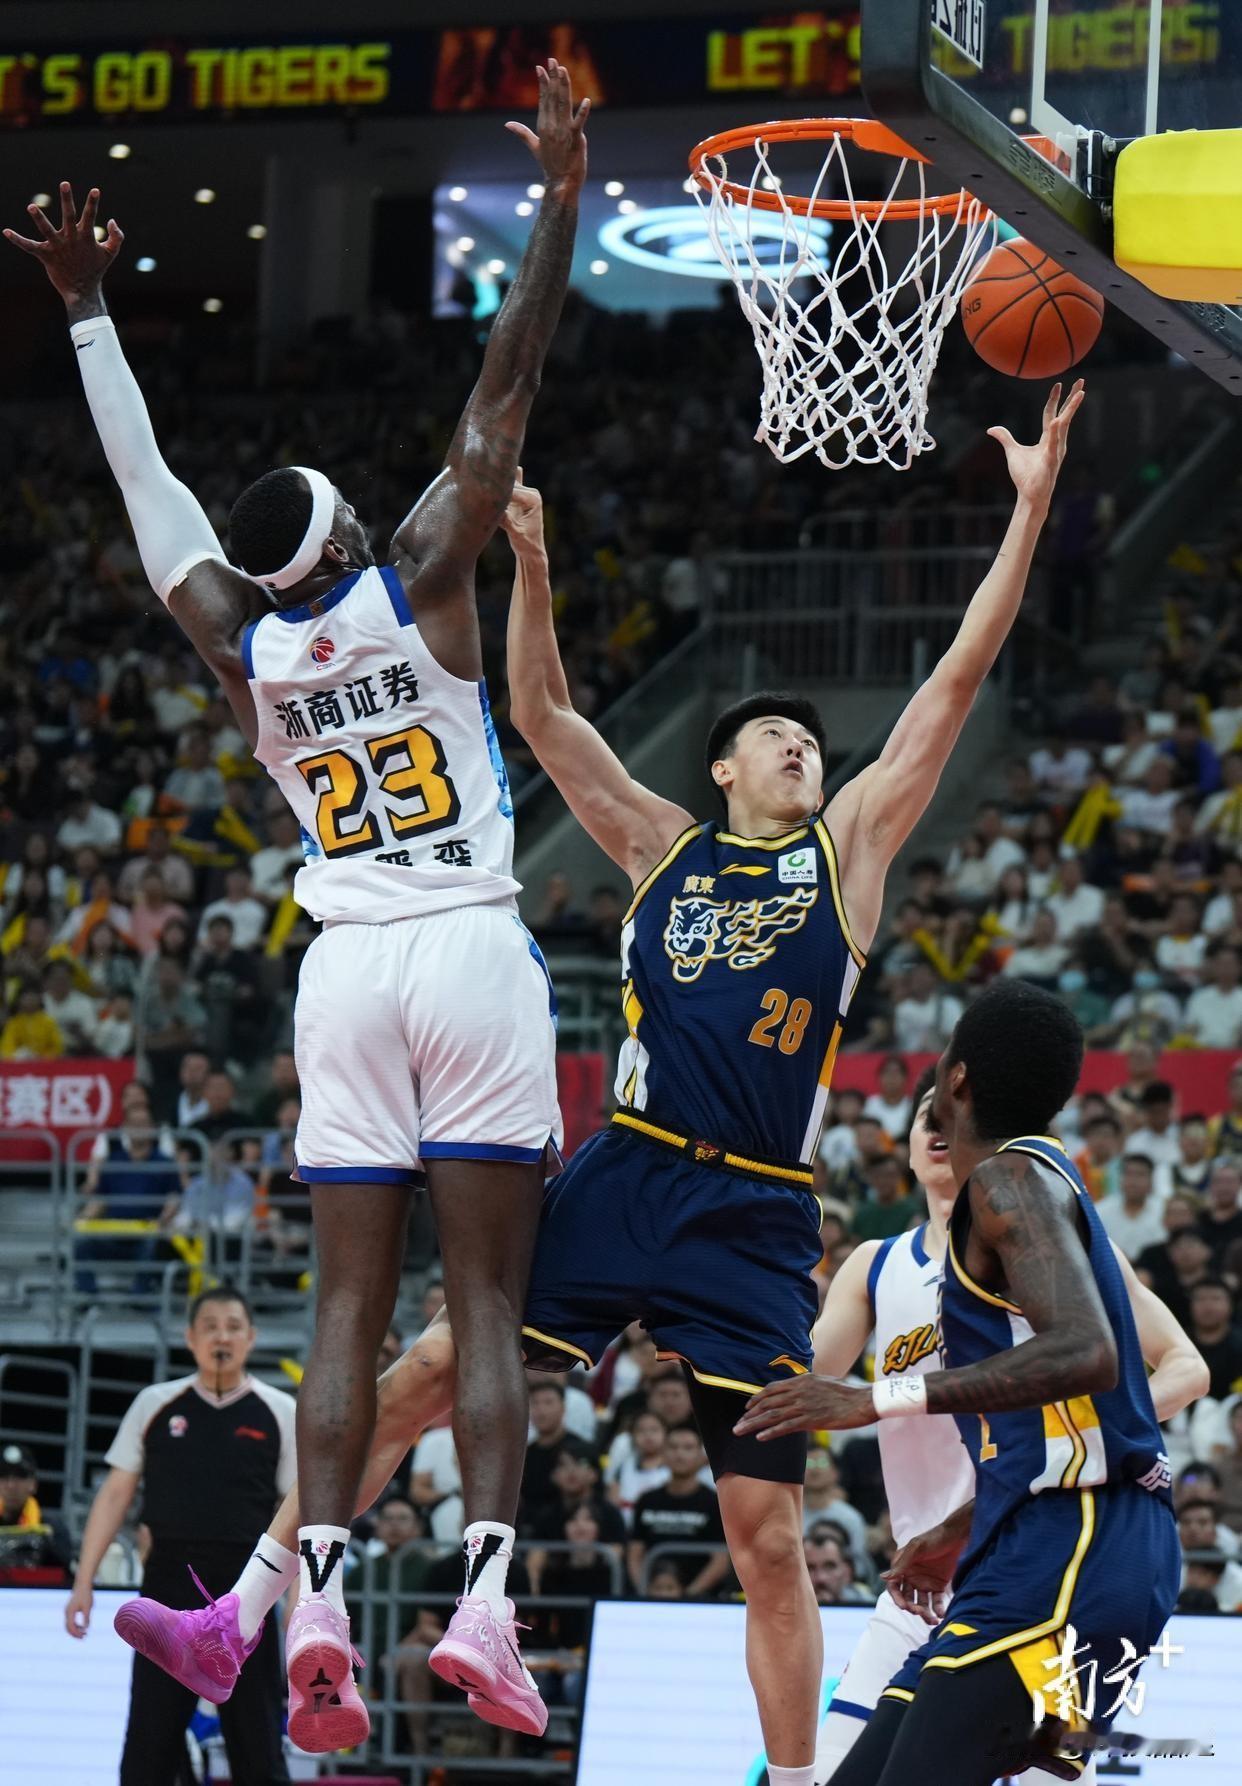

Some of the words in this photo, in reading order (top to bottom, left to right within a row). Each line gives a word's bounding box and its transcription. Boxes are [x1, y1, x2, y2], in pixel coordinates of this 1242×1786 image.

[94, 51, 172, 113] GO
[186, 42, 391, 109] TIGERS
[273, 661, 418, 740] 浙商证券
[295, 724, 462, 859] 23
[747, 988, 812, 1055] 28
[0, 1074, 113, 1127] 赛区)
